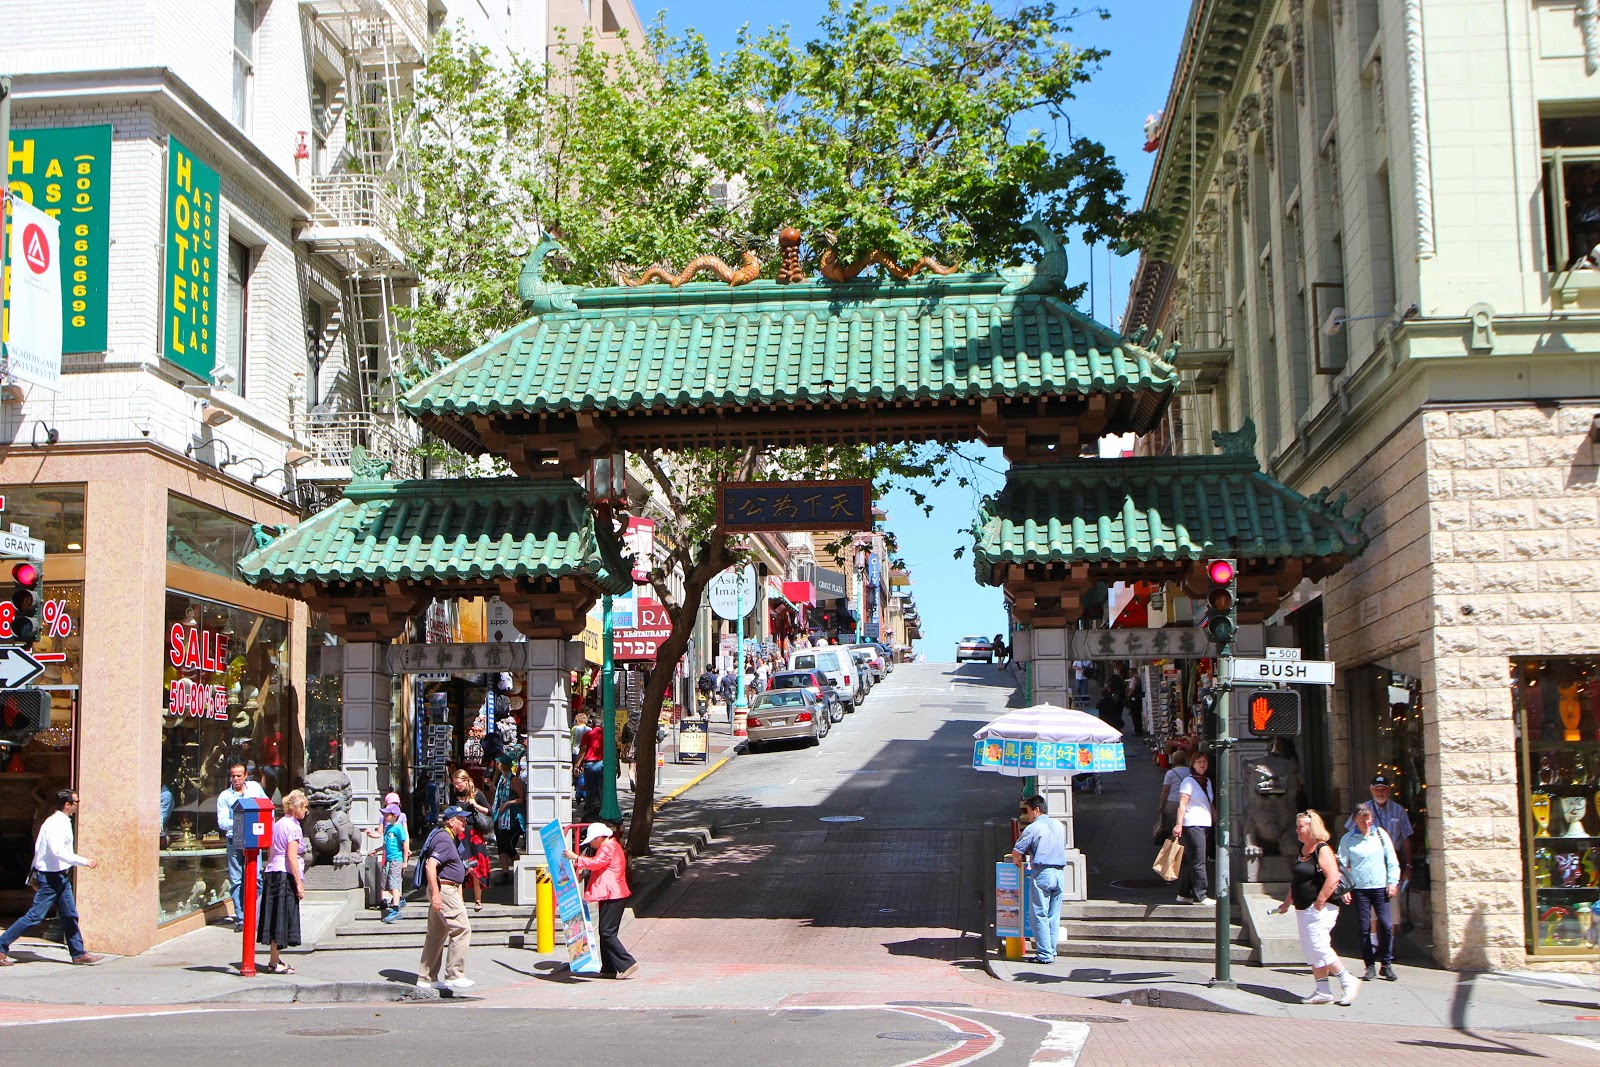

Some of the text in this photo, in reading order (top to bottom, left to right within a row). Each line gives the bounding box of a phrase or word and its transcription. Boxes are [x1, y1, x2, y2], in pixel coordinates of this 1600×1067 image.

[71, 154, 96, 328] (800) 6666696
[173, 151, 191, 354] HOTEL
[190, 187, 201, 351] ASTORIA
[201, 192, 213, 355] (800) 6666696
[10, 357, 58, 382] UNIVERSITY
[11, 347, 41, 365] ACADEMY
[45, 359, 58, 371] ART
[738, 493, 855, 518] 天下為公
[4, 537, 36, 554] GRANT
[717, 575, 749, 585] Asin
[831, 583, 844, 594] PLAZA
[617, 616, 632, 625] OFF
[623, 629, 671, 638] RESTAURANT
[170, 623, 228, 673] SALE
[1279, 650, 1298, 658] 500
[1259, 664, 1308, 677] BUSH
[169, 680, 215, 719] 50-80%
